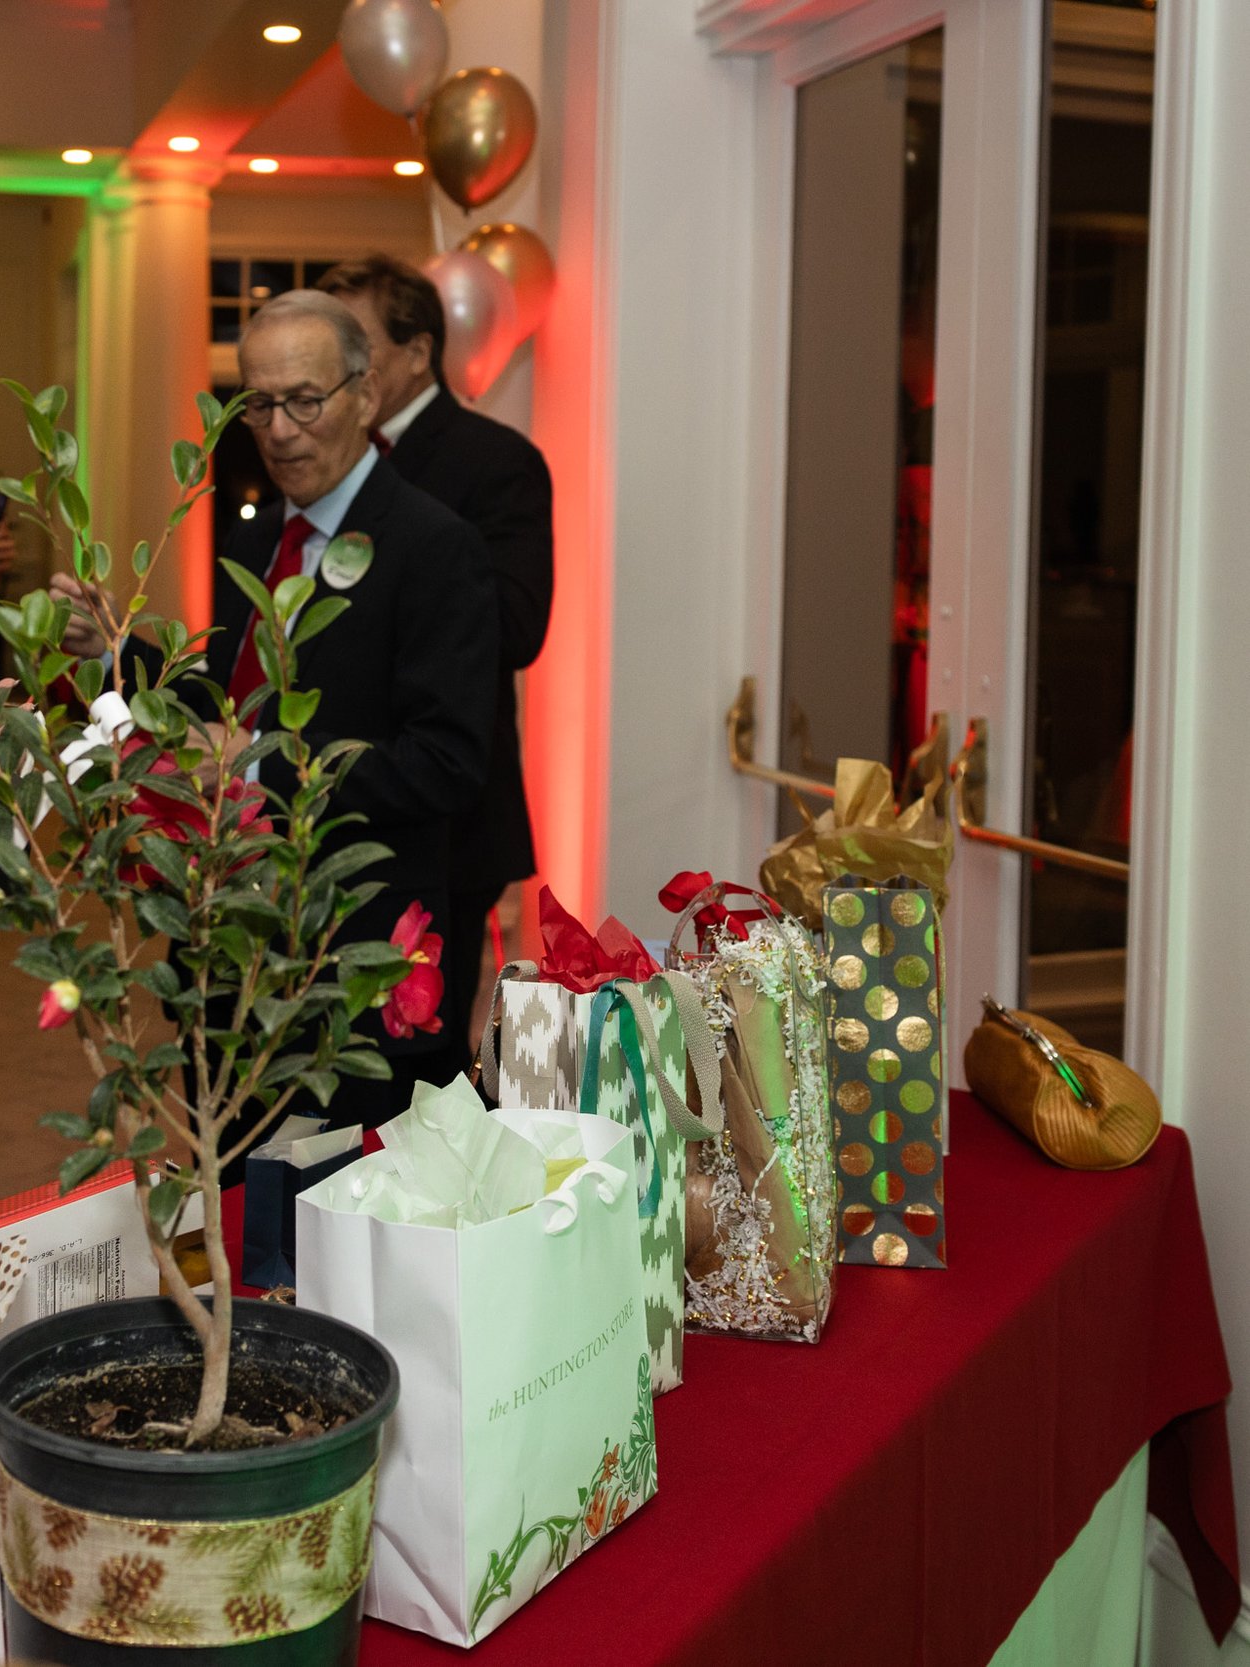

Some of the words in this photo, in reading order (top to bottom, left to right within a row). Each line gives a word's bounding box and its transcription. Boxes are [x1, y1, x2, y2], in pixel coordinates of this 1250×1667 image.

[488, 1398, 509, 1422] the
[513, 1328, 610, 1409] HUNTINGTON
[611, 1297, 635, 1341] STORE
